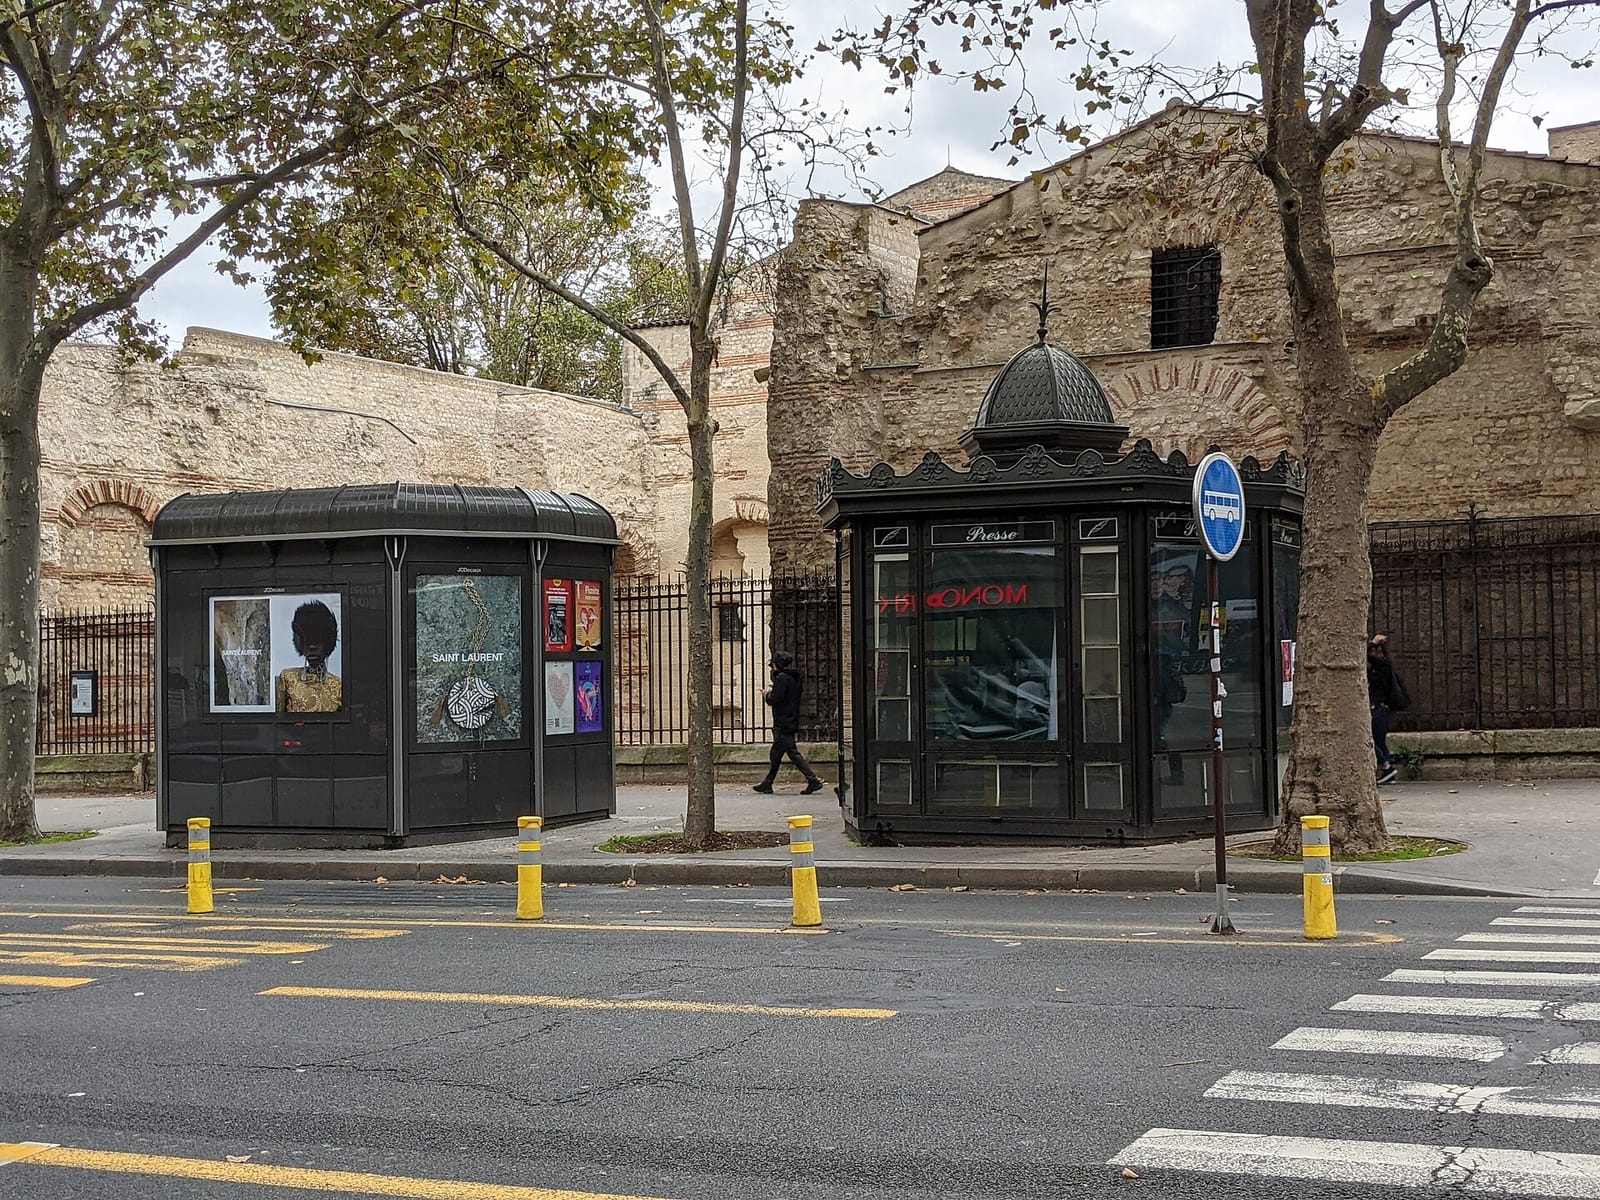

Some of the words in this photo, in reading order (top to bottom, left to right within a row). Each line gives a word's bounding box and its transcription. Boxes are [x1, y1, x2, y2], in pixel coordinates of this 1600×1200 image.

[966, 526, 1019, 541] Presse
[432, 653, 459, 662] SAINT
[461, 652, 504, 662] LAURENT
